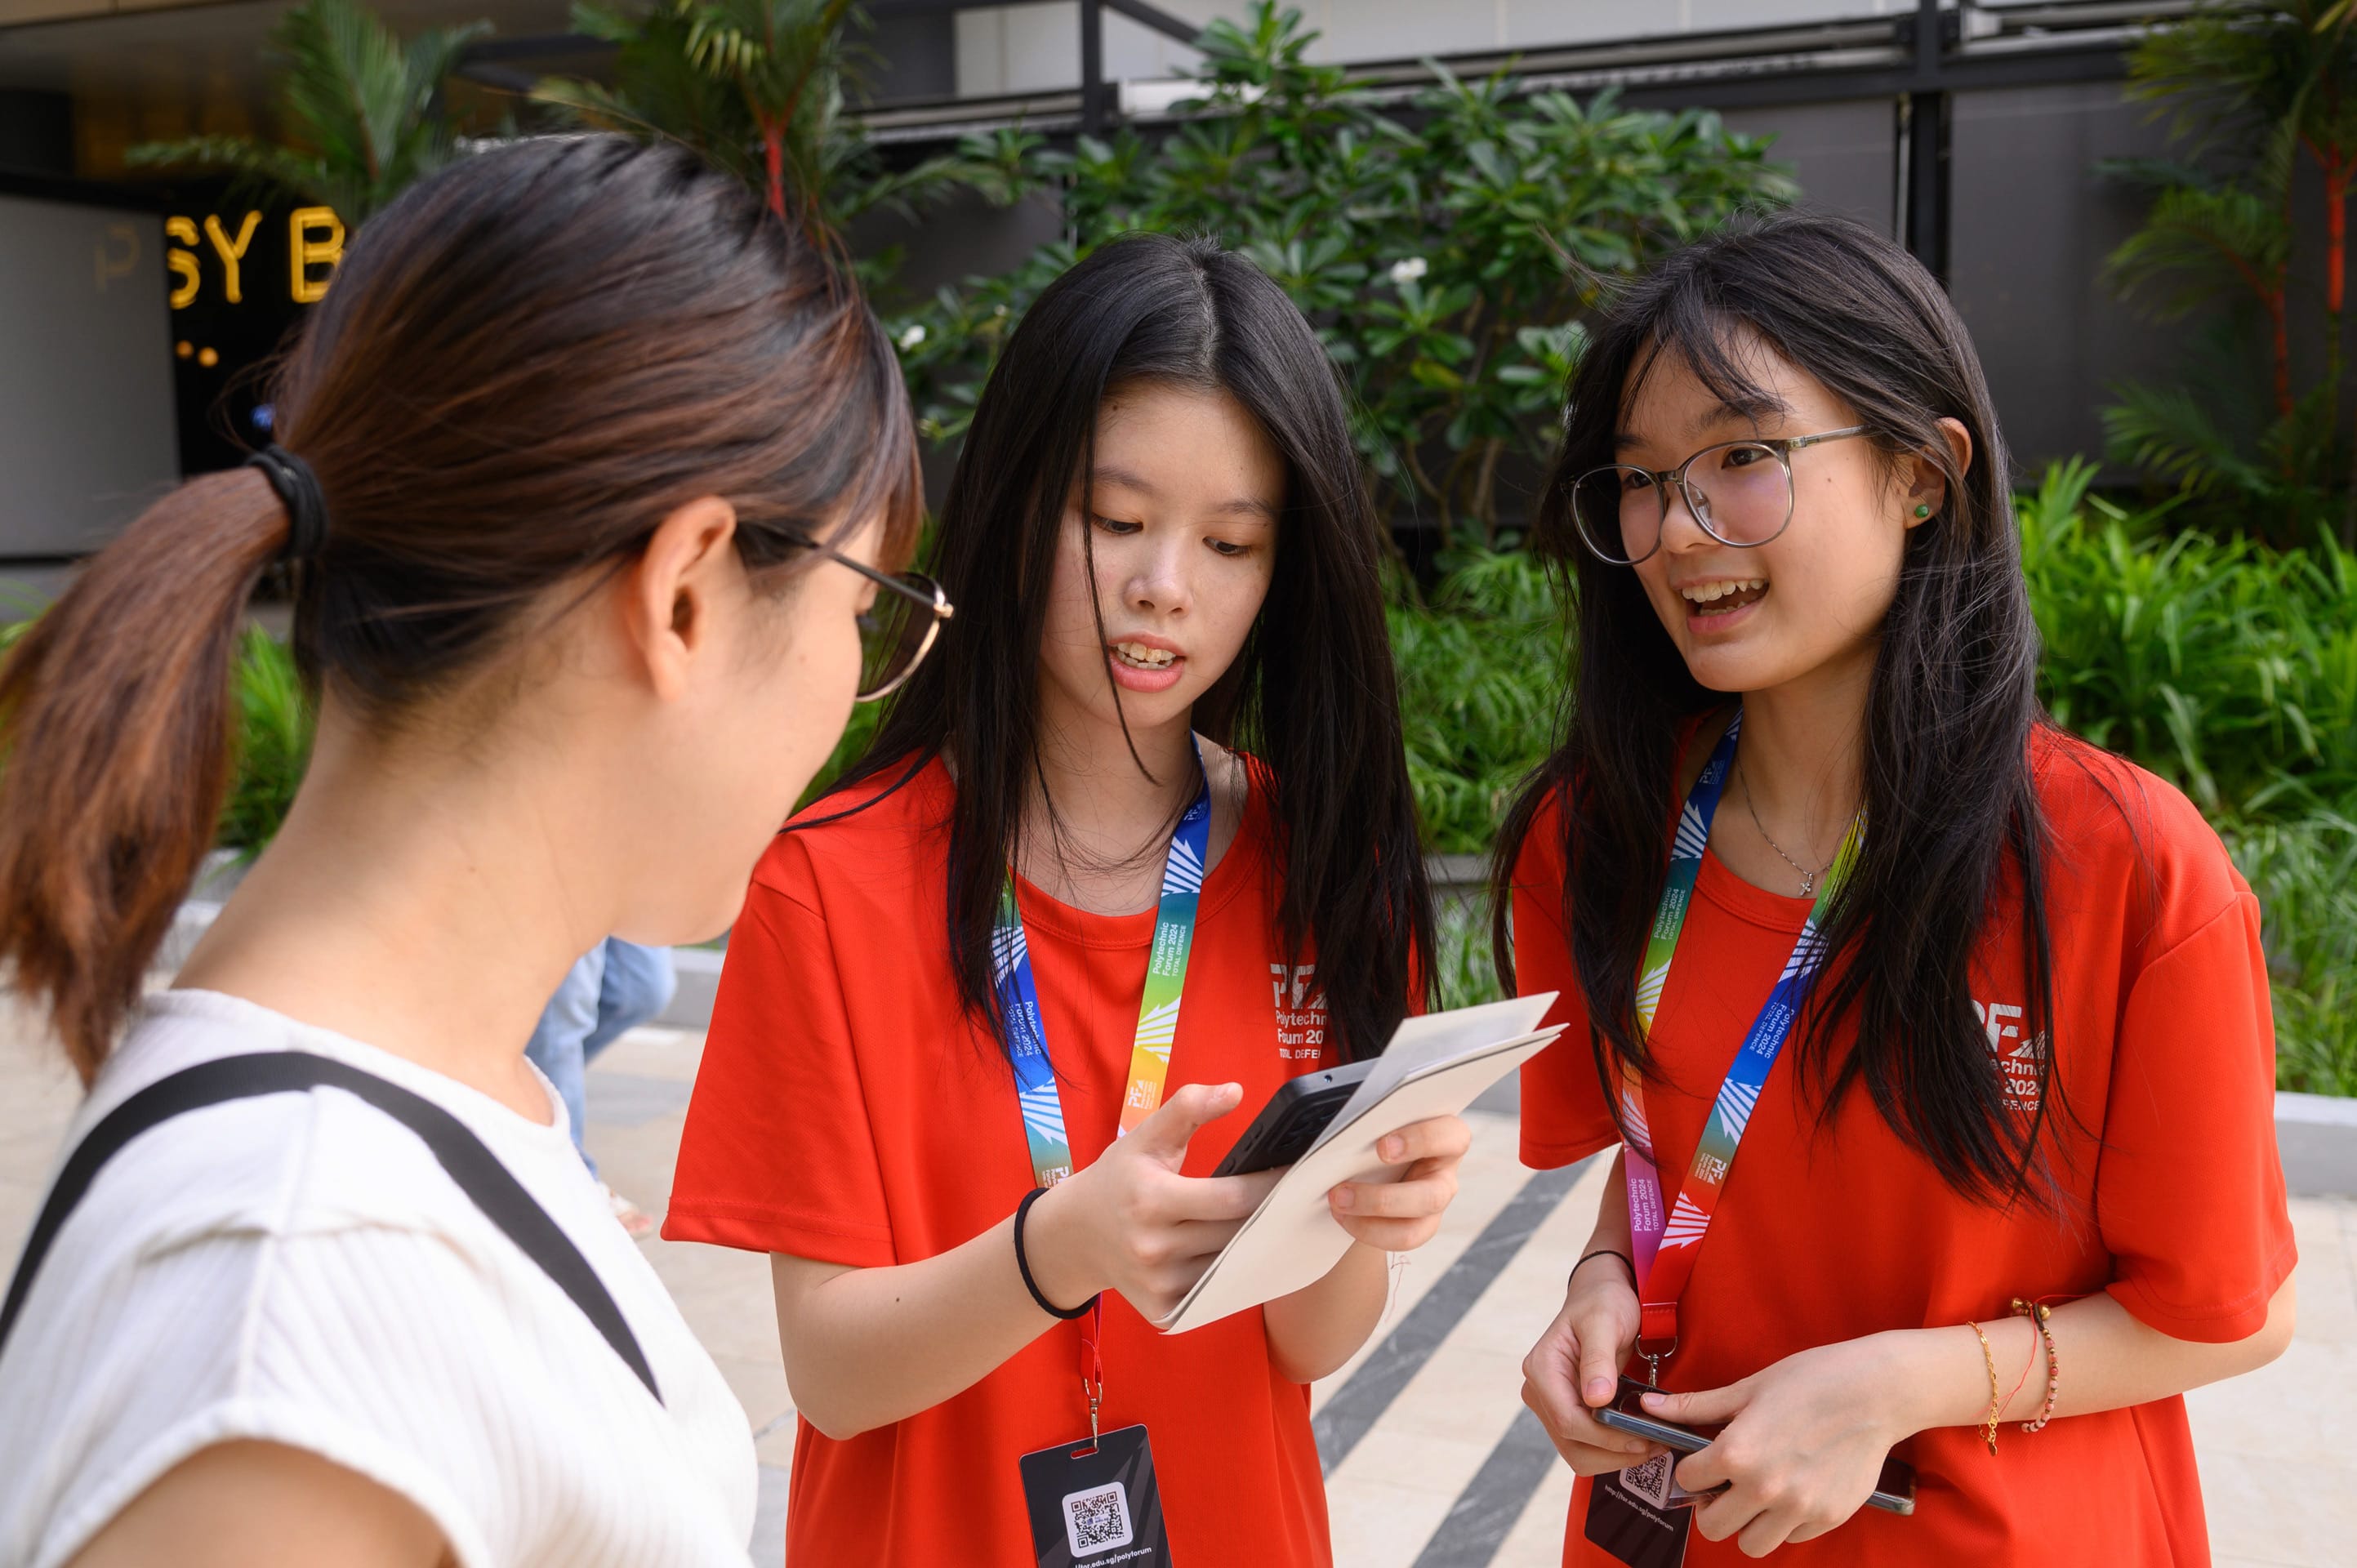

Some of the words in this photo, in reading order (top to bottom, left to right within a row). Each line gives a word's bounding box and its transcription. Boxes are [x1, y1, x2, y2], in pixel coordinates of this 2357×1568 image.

[1654, 887, 1672, 938] Polytechnic
[1661, 911, 1673, 940] Forum
[1669, 889, 1679, 909] 2024
[1669, 920, 1678, 940] TOTAL
[1674, 889, 1686, 920] DEFENCE
[1152, 922, 1170, 974] Polytechnic
[1168, 924, 1178, 945] 2024
[1176, 924, 1187, 956] DEFENCE
[1162, 947, 1175, 976] Forum
[1172, 956, 1182, 977] TOTAL
[1767, 1004, 1788, 1032] Forum
[1022, 1034, 1033, 1056] 2024
[1756, 1033, 1771, 1055] 2024
[1638, 1178, 1648, 1200] 2024
[1646, 1178, 1656, 1209] DEFENCE
[1630, 1178, 1642, 1232] Polytechnic
[1642, 1202, 1652, 1232] Forum
[1651, 1209, 1660, 1231] TOTAL
